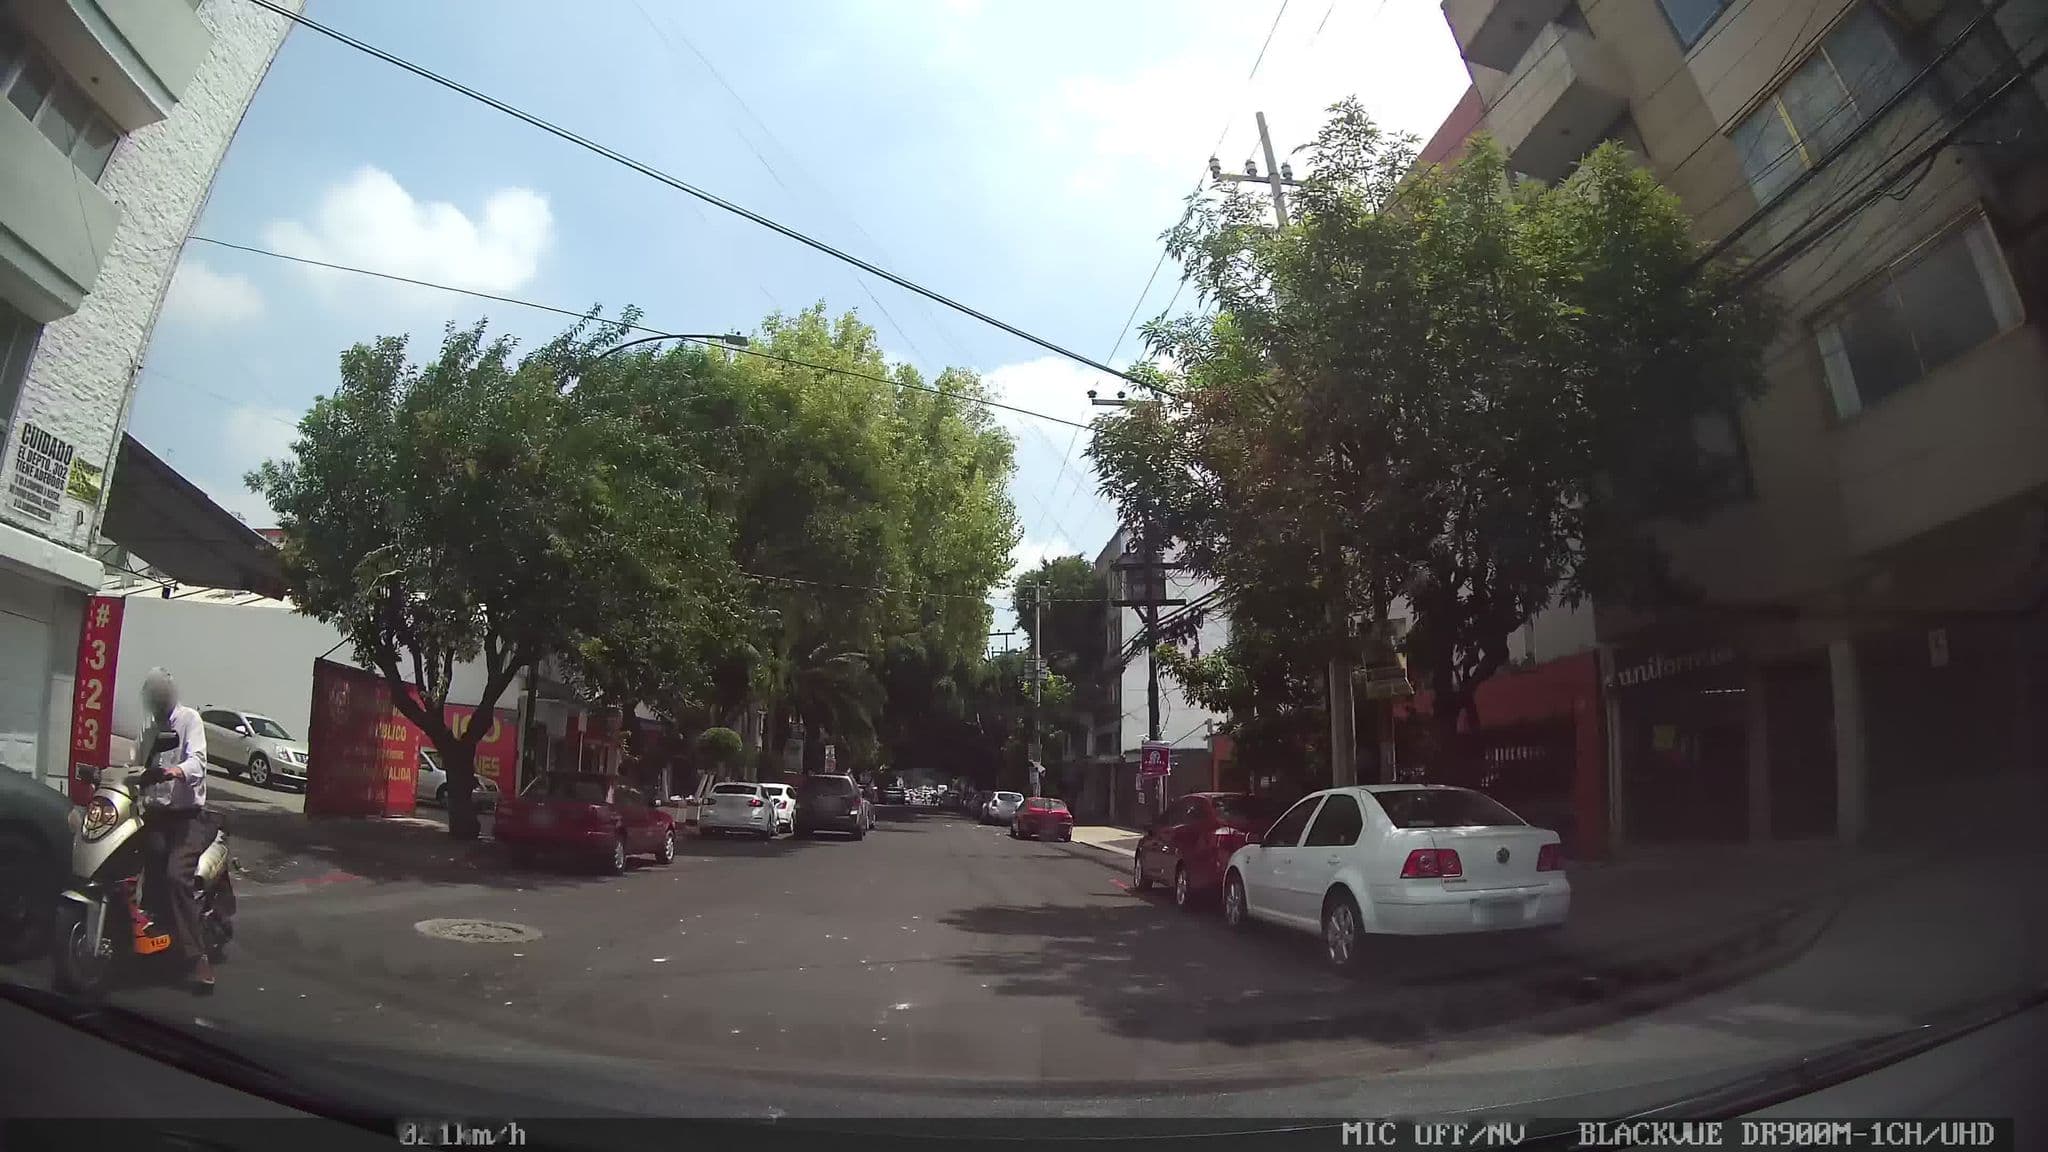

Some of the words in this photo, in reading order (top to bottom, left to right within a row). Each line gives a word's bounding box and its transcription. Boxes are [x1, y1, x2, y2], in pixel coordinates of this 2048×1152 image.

[20, 422, 74, 466] CUIDADO
[15, 458, 35, 478] TIENE
[33, 466, 66, 491] ADEUDOS
[17, 445, 26, 460] EL
[52, 462, 69, 480] 302
